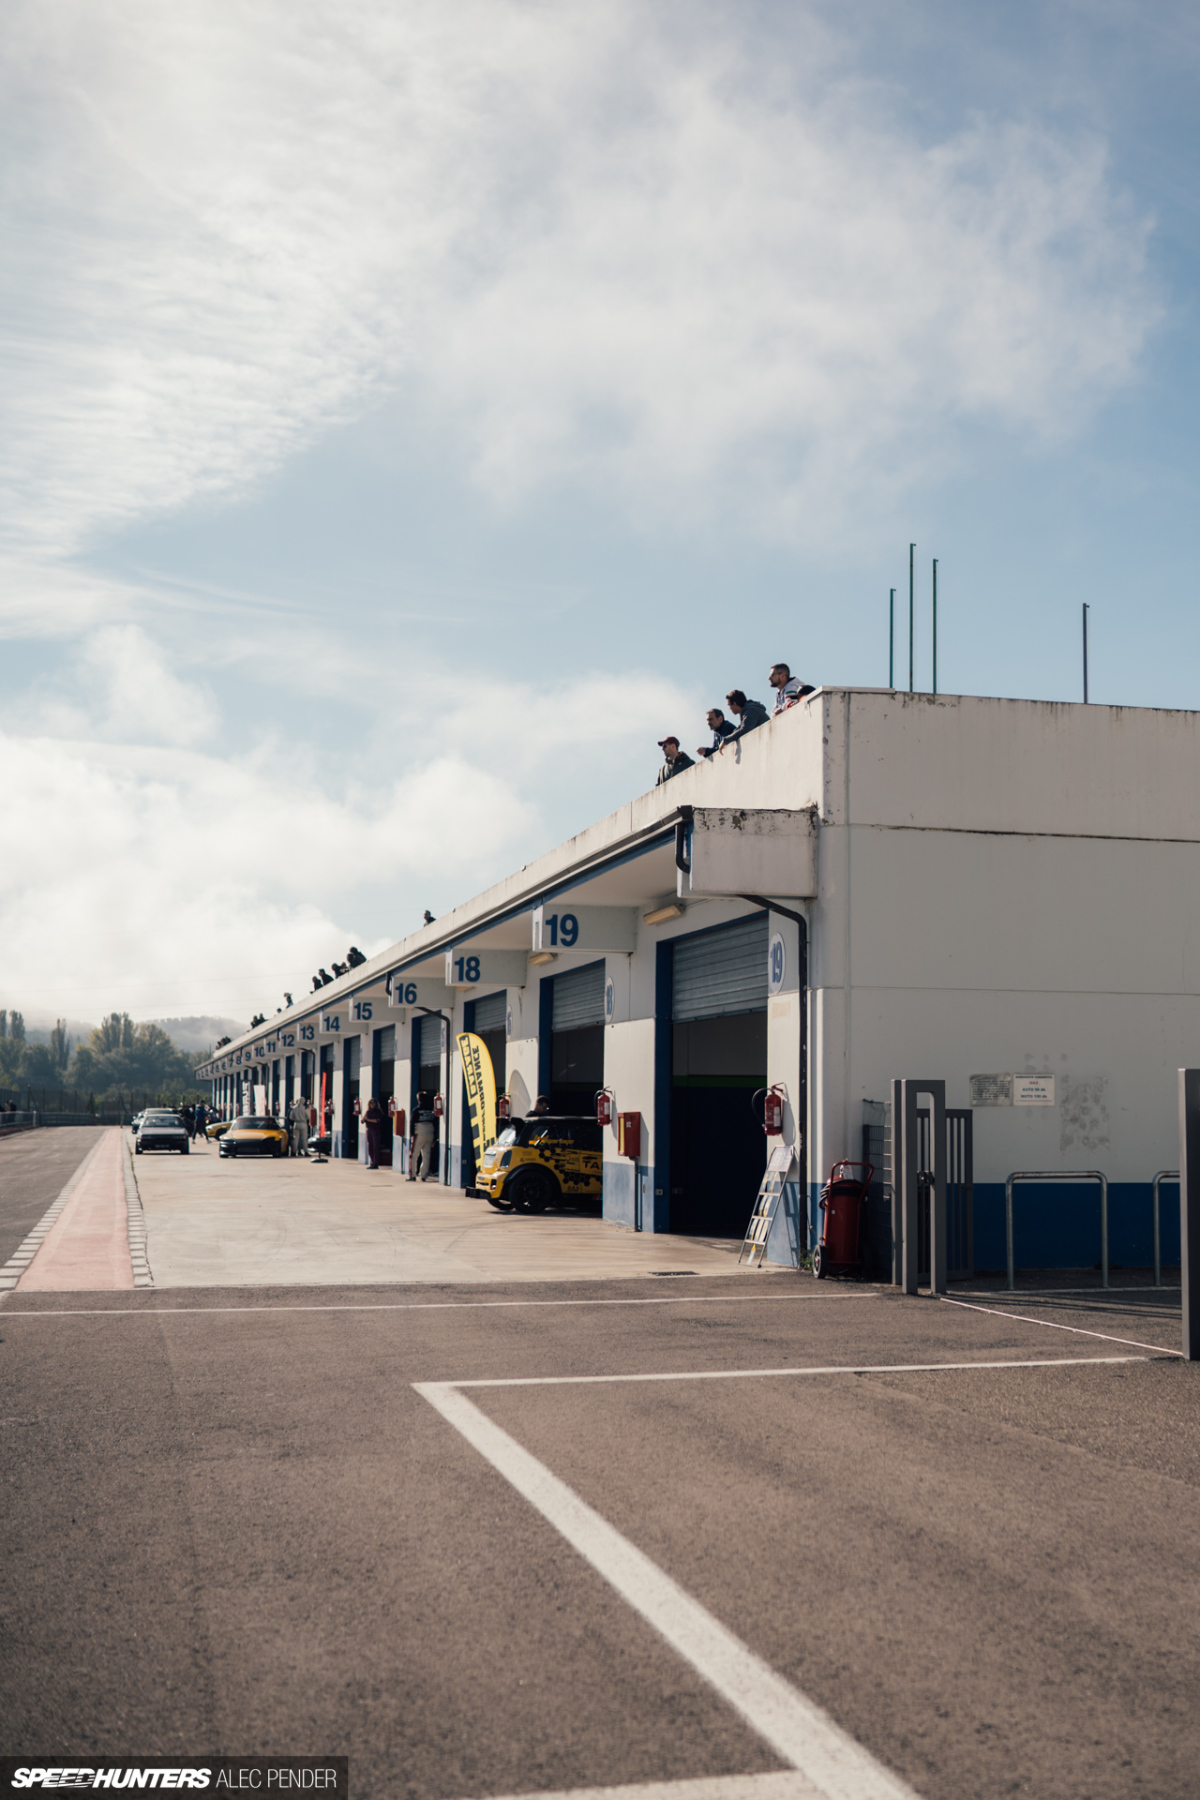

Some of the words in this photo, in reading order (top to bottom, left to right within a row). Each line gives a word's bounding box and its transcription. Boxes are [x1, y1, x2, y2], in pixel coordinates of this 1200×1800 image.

[545, 914, 579, 947] 19
[770, 941, 783, 983] 19
[454, 956, 481, 983] 18
[395, 983, 418, 1005] 16
[354, 1002, 373, 1021] 15
[323, 1016, 340, 1032] 14
[300, 1025, 315, 1040] 13
[266, 1041, 276, 1053] 11
[281, 1034, 295, 1047] 12
[245, 1052, 252, 1062] 9
[254, 1046, 265, 1058] 10
[221, 1062, 227, 1071] 6
[236, 1055, 242, 1065] 8
[582, 1161, 603, 1171] TA
